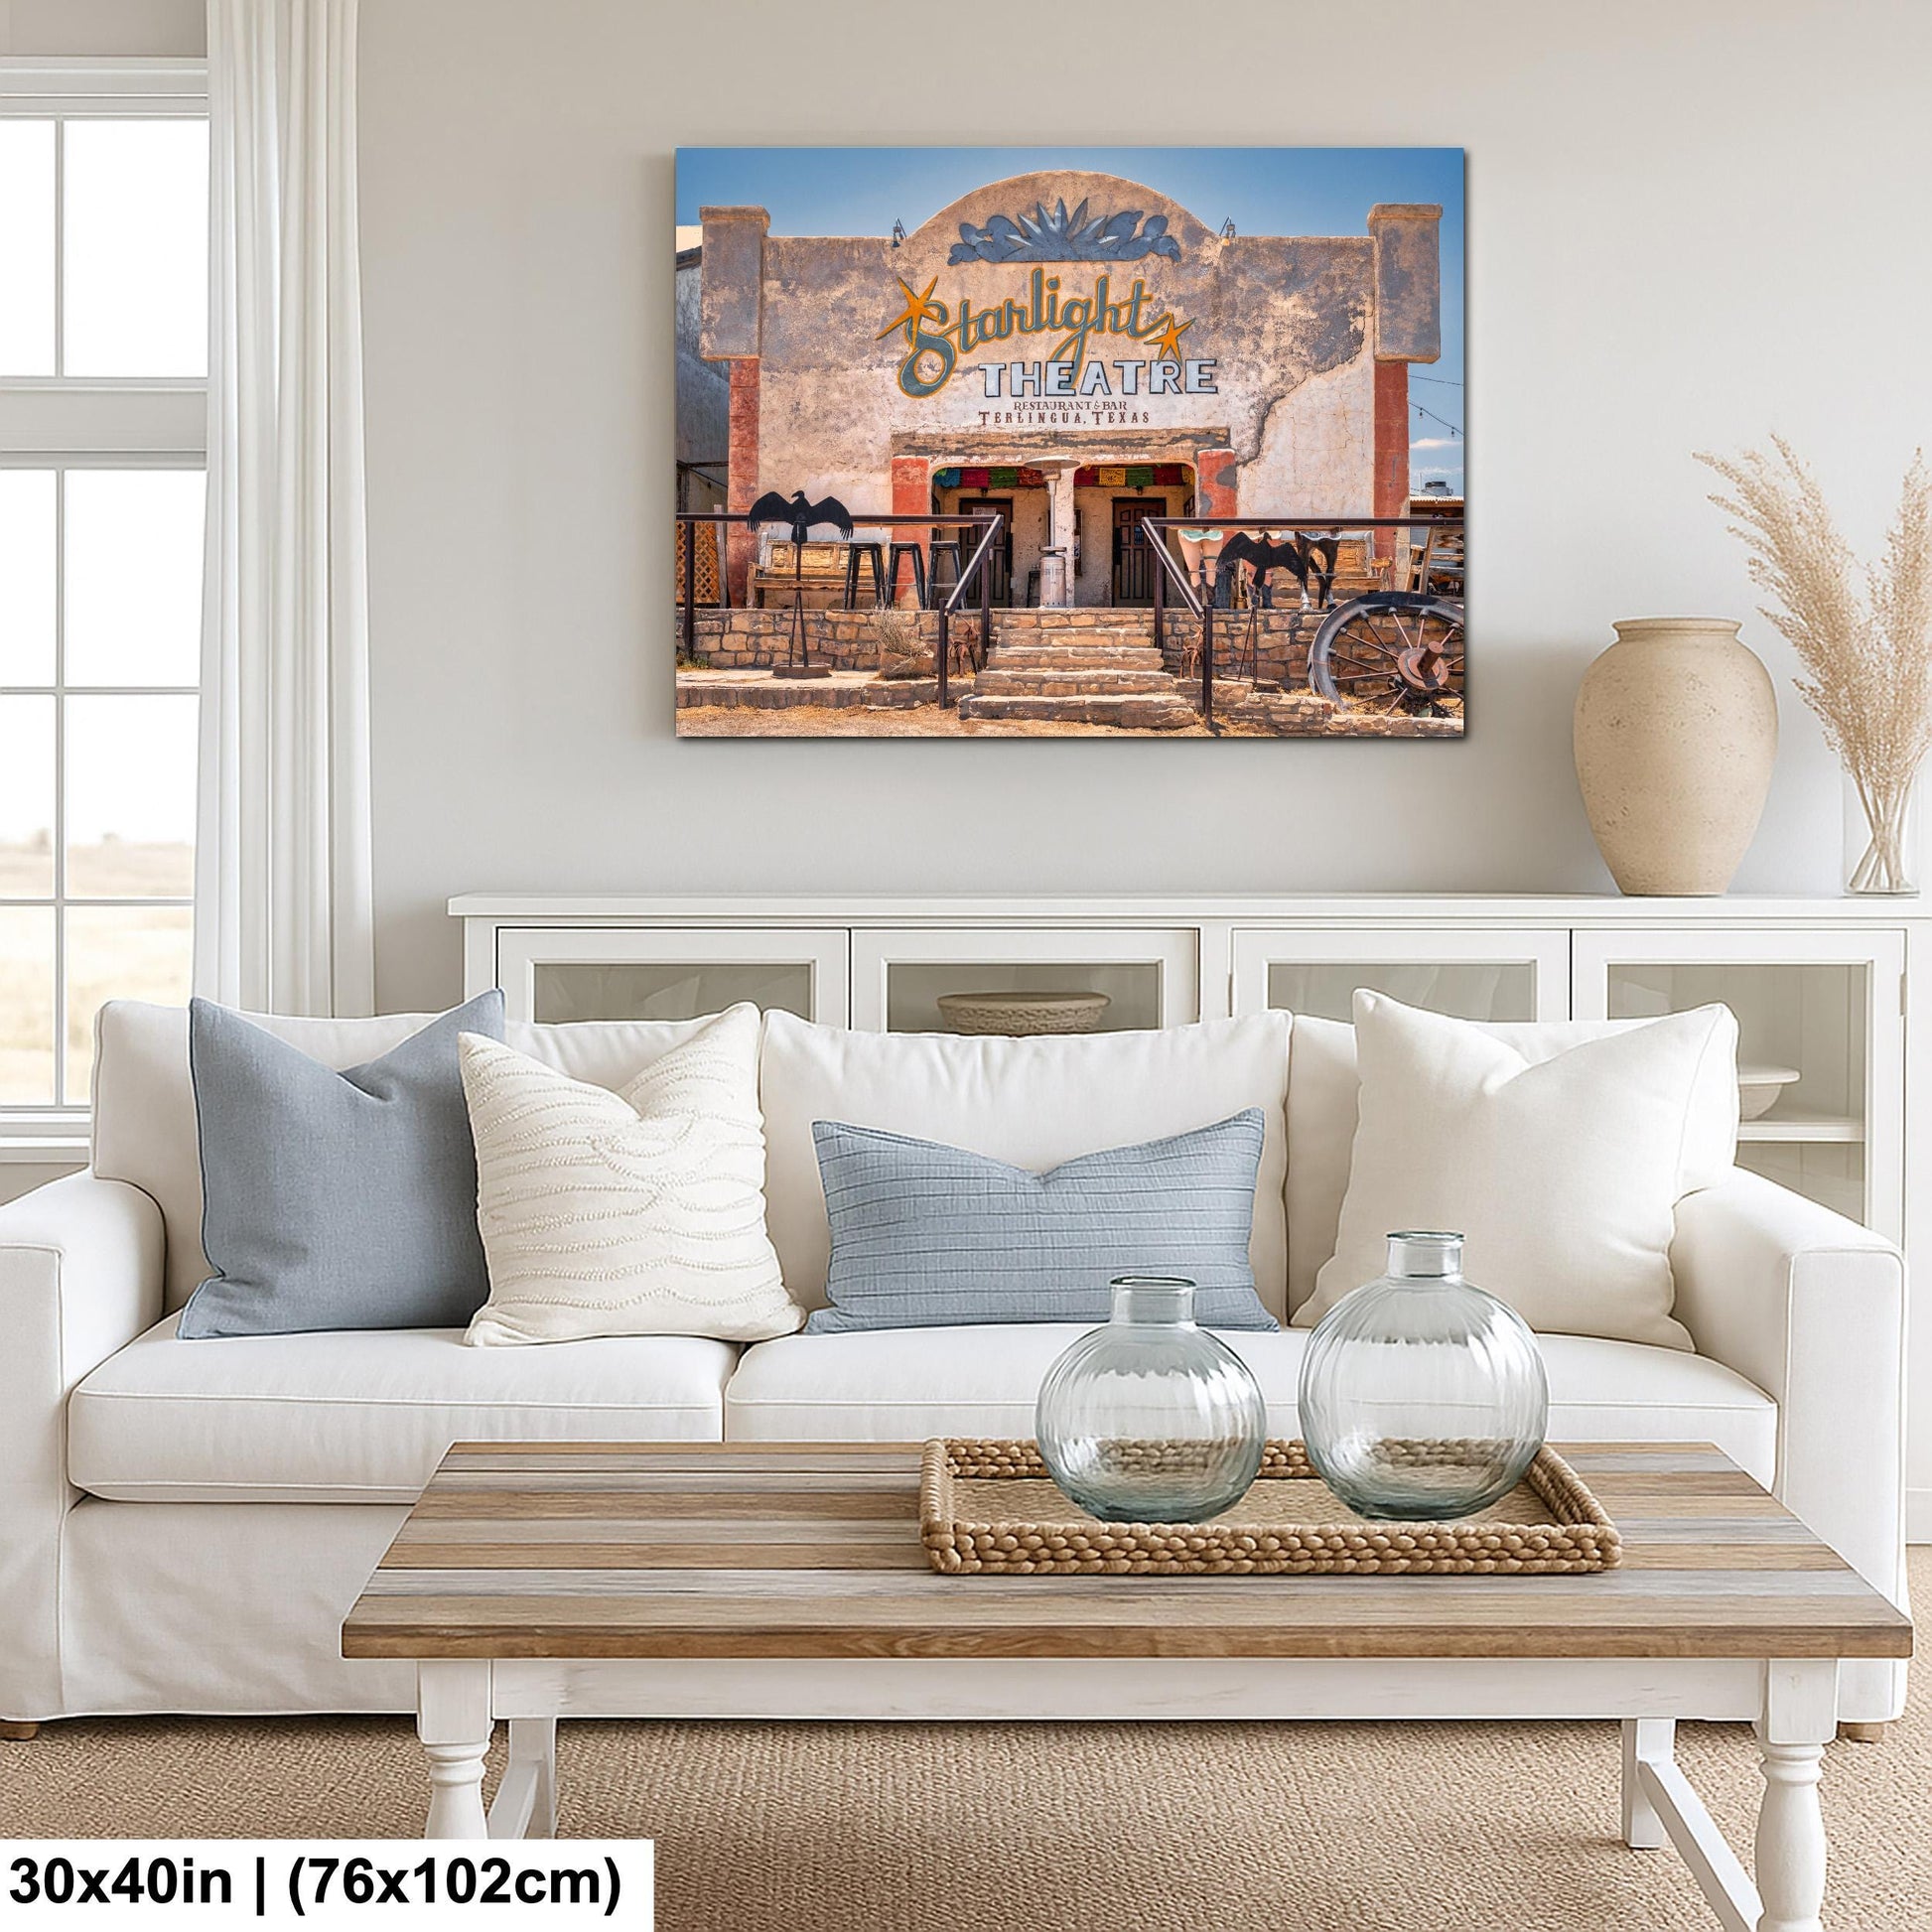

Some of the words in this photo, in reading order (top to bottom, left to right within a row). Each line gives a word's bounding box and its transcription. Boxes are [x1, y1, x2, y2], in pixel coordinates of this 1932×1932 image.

[897, 267, 1173, 398] Starlight
[978, 358, 1219, 398] THEATRE
[978, 410, 1087, 426] TERLINGUA,
[1092, 411, 1150, 426] TEXAS
[1014, 401, 1091, 412] RESTAURANT
[1103, 401, 1128, 411] BAR
